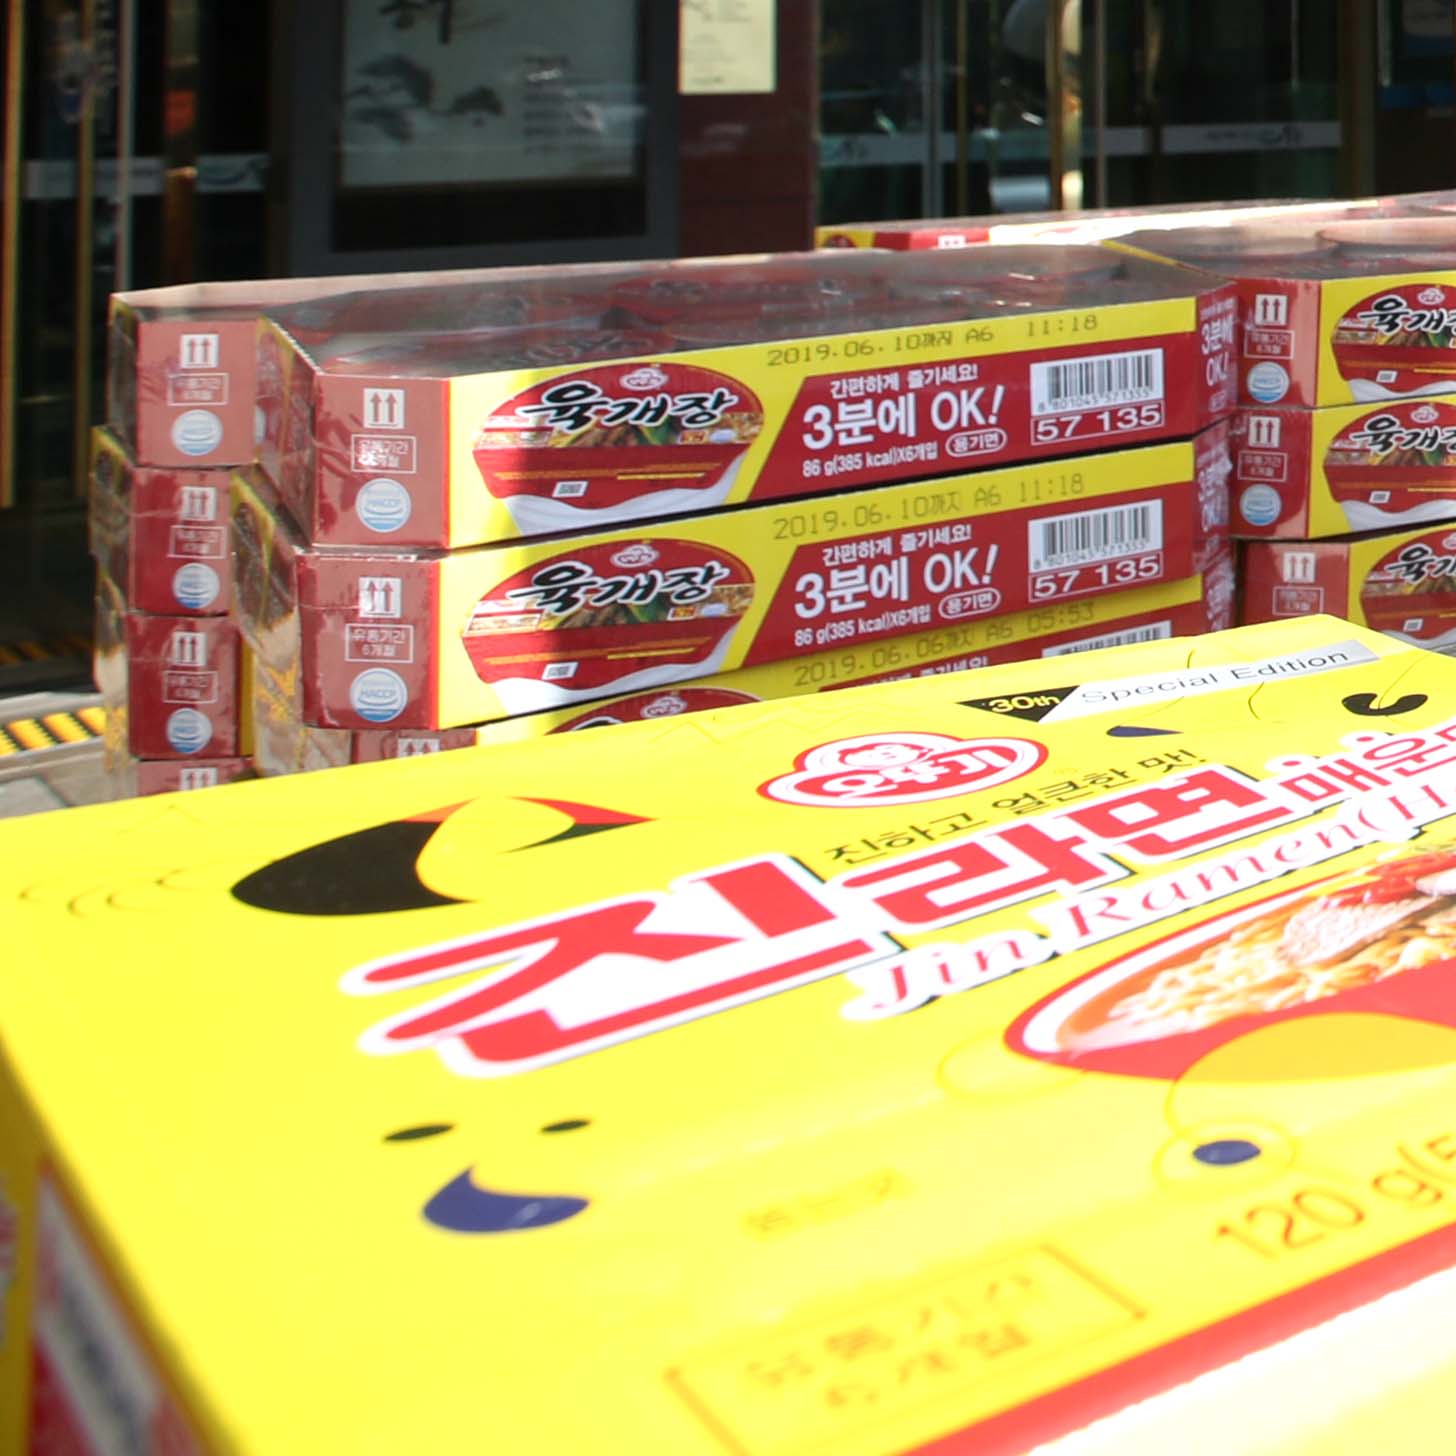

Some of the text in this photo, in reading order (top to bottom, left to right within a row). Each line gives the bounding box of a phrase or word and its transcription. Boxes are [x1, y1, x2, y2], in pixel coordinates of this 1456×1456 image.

[966, 324, 994, 344] A6
[1026, 314, 1098, 337] 11:18
[515, 381, 738, 433] 육개장
[830, 363, 979, 399] 간편하게 즐기세요!
[801, 385, 1005, 452] 3분에 OK!
[1035, 407, 1162, 442] 57 135
[973, 487, 1001, 508] A6
[1018, 474, 1084, 505] 11:18
[822, 525, 972, 566] 간편하게 즐기세요!
[505, 561, 730, 616] 육개장
[793, 544, 1000, 620] 3분에 OK!
[1033, 557, 1160, 601] 57 135
[1026, 603, 1095, 633] 05:53
[989, 648, 1351, 716] 30th Special Edition
[816, 747, 1008, 803] 오뚜기
[827, 810, 987, 870] 진하고
[992, 768, 1132, 816] 얼큰한
[362, 766, 1296, 1065] 진라면
[870, 932, 1034, 1011] Jin
[1219, 1188, 1365, 1260] 120
